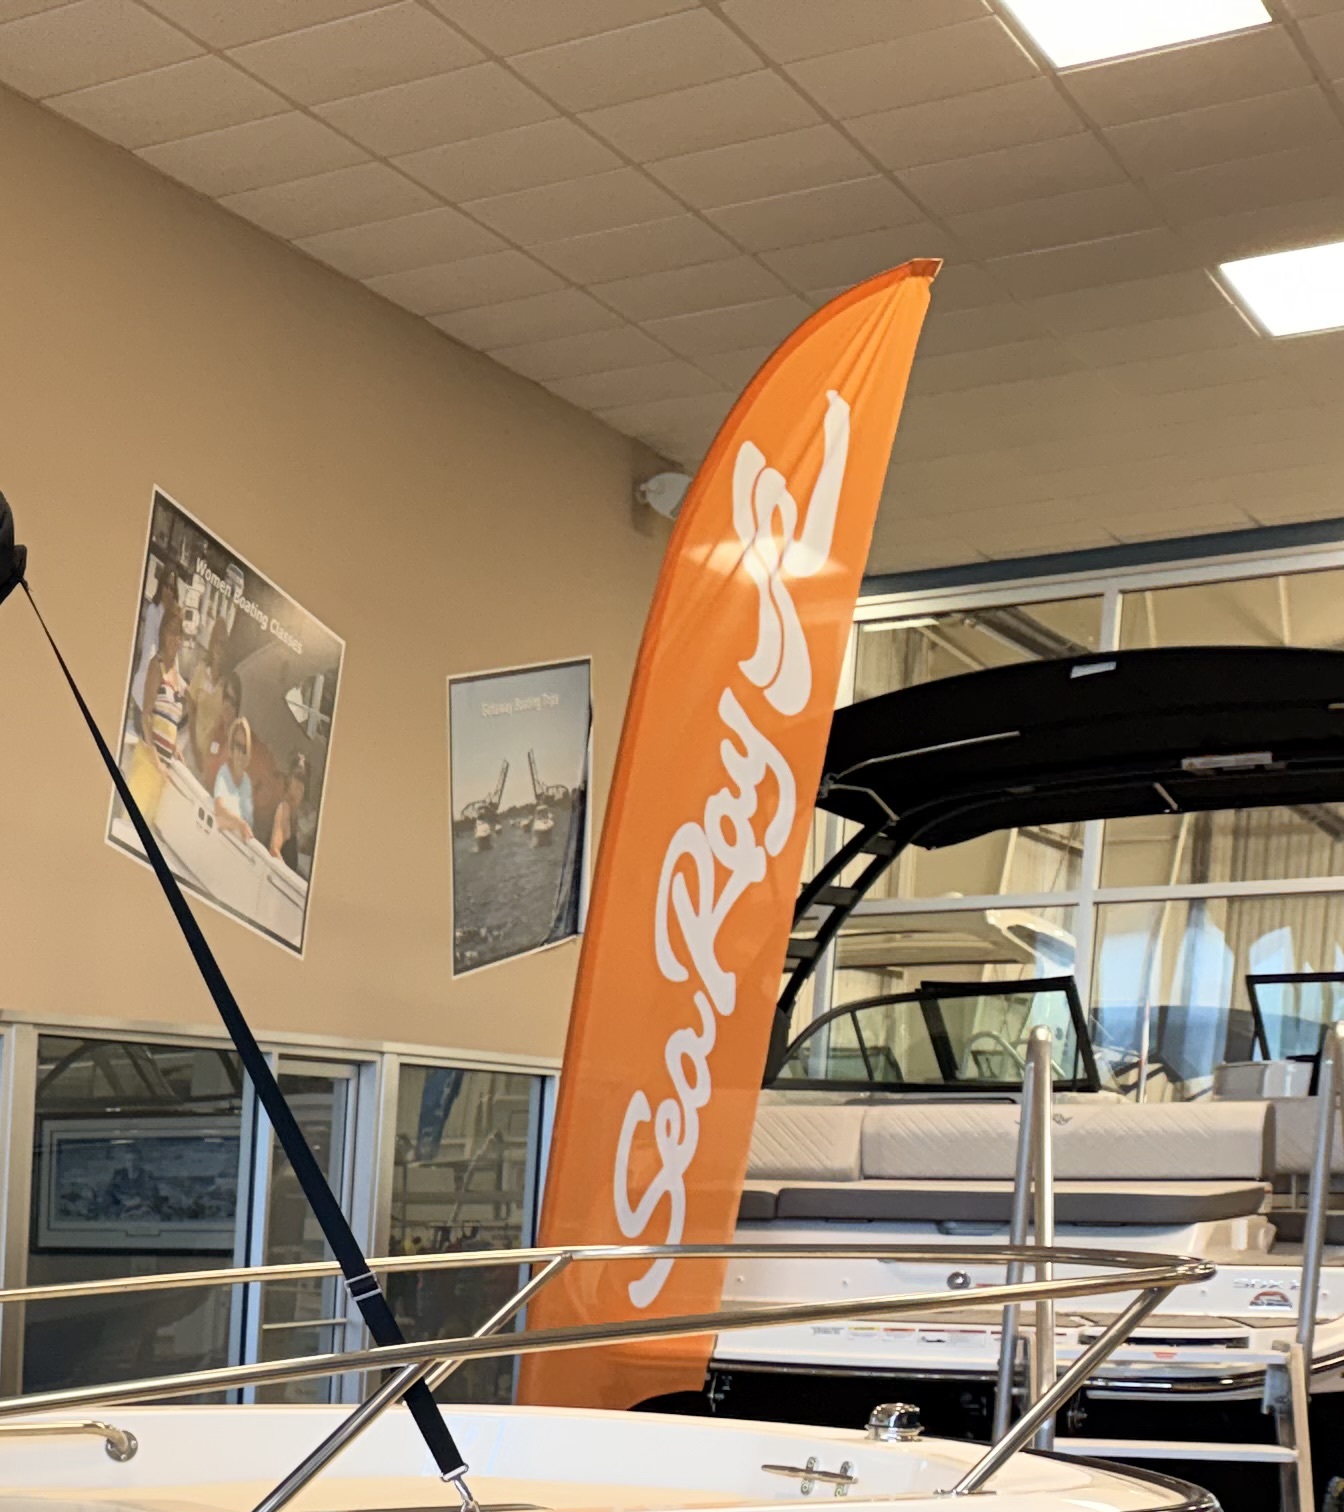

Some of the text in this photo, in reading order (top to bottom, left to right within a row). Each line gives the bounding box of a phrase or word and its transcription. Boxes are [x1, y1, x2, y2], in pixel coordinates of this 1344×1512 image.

[196, 557, 303, 655] Women Boating Classes
[614, 686, 797, 1309] Sea Ray
